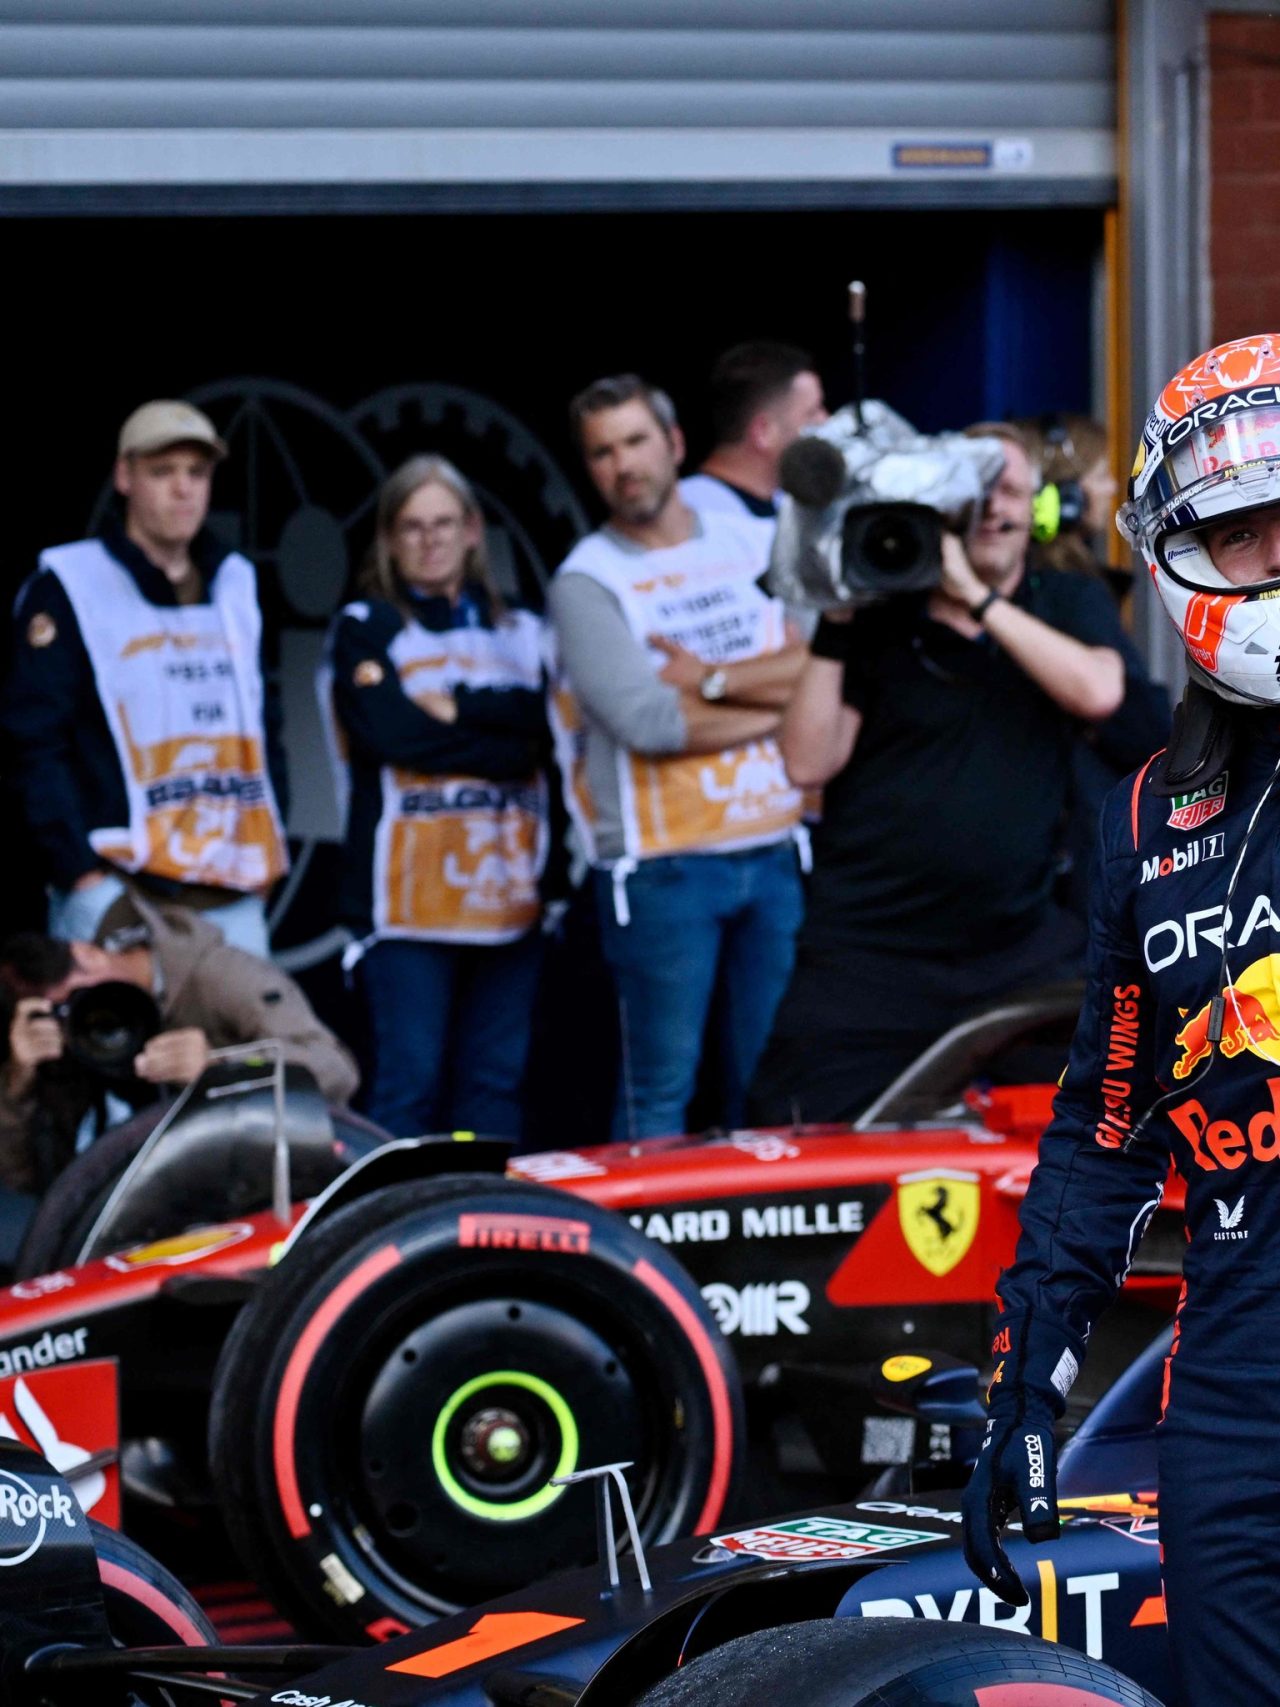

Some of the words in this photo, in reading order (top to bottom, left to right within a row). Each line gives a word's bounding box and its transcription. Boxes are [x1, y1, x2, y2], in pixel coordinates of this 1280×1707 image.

[1171, 798, 1222, 826] HEUER
[1140, 840, 1200, 885] Mobil
[1105, 983, 1142, 1071] WINGS
[459, 1212, 590, 1254] PIRELLI
[742, 1201, 865, 1239] MILLE
[1213, 1230, 1248, 1240] CASTORE
[1024, 1434, 1045, 1488] sparco
[795, 1520, 920, 1545] TAG
